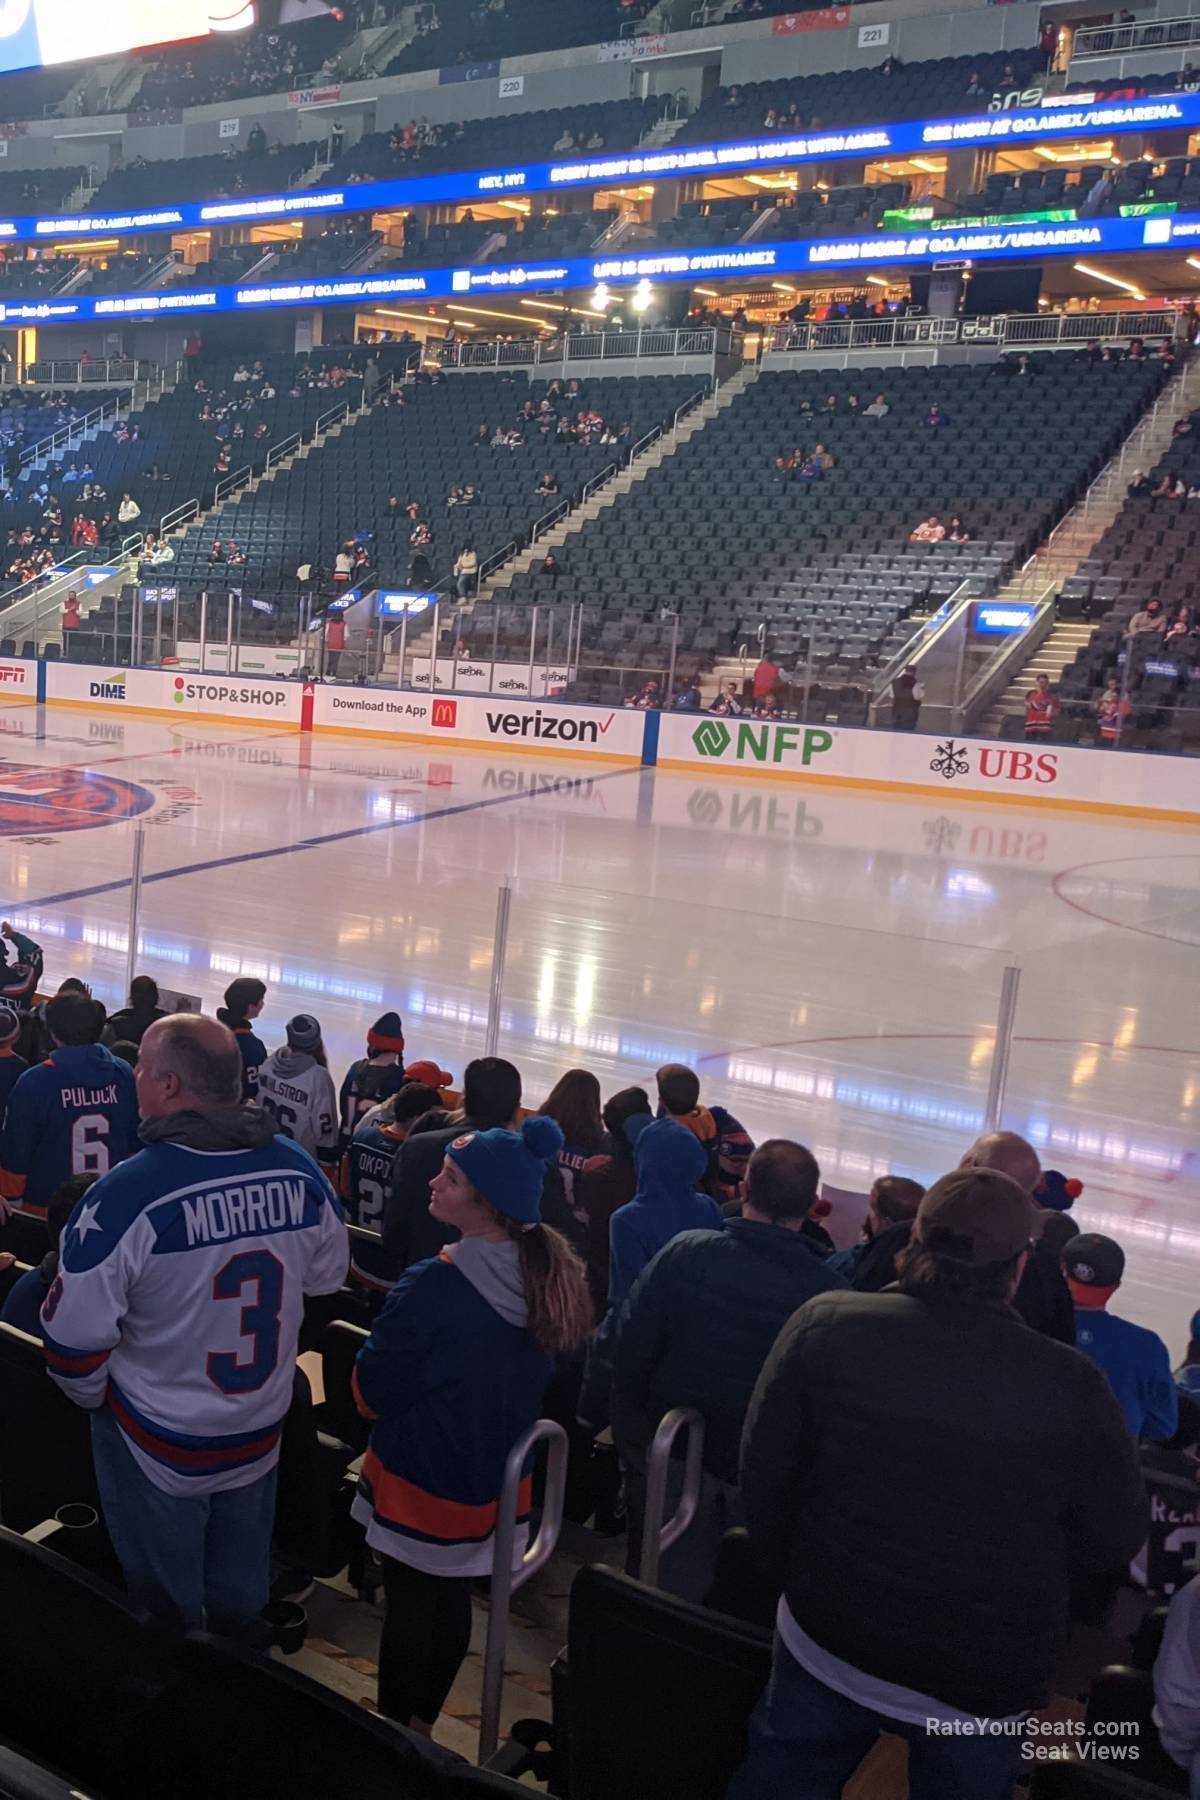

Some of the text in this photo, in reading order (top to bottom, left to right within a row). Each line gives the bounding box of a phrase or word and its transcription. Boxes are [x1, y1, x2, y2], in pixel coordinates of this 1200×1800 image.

[863, 29, 883, 42] 221
[503, 82, 520, 93] 220
[989, 118, 1013, 136] AT
[1011, 104, 1182, 133] GO.AMEX/UBSARENA.
[478, 173, 525, 189] HEY, NY!
[928, 228, 1101, 253] GO.AMEX/UBSARENA
[90, 683, 126, 700] DIME
[415, 675, 441, 685] SPR
[186, 686, 286, 707] STOP&SHOP
[333, 697, 427, 718] Download the App
[486, 709, 598, 743] verizon
[736, 723, 833, 766] NFP
[977, 747, 1059, 784] UBS
[259, 1075, 308, 1105] WLSTROM
[72, 1115, 110, 1176] 6
[358, 1152, 390, 1178] OKPO
[180, 1180, 306, 1246] MORROW
[206, 1248, 285, 1396] 3
